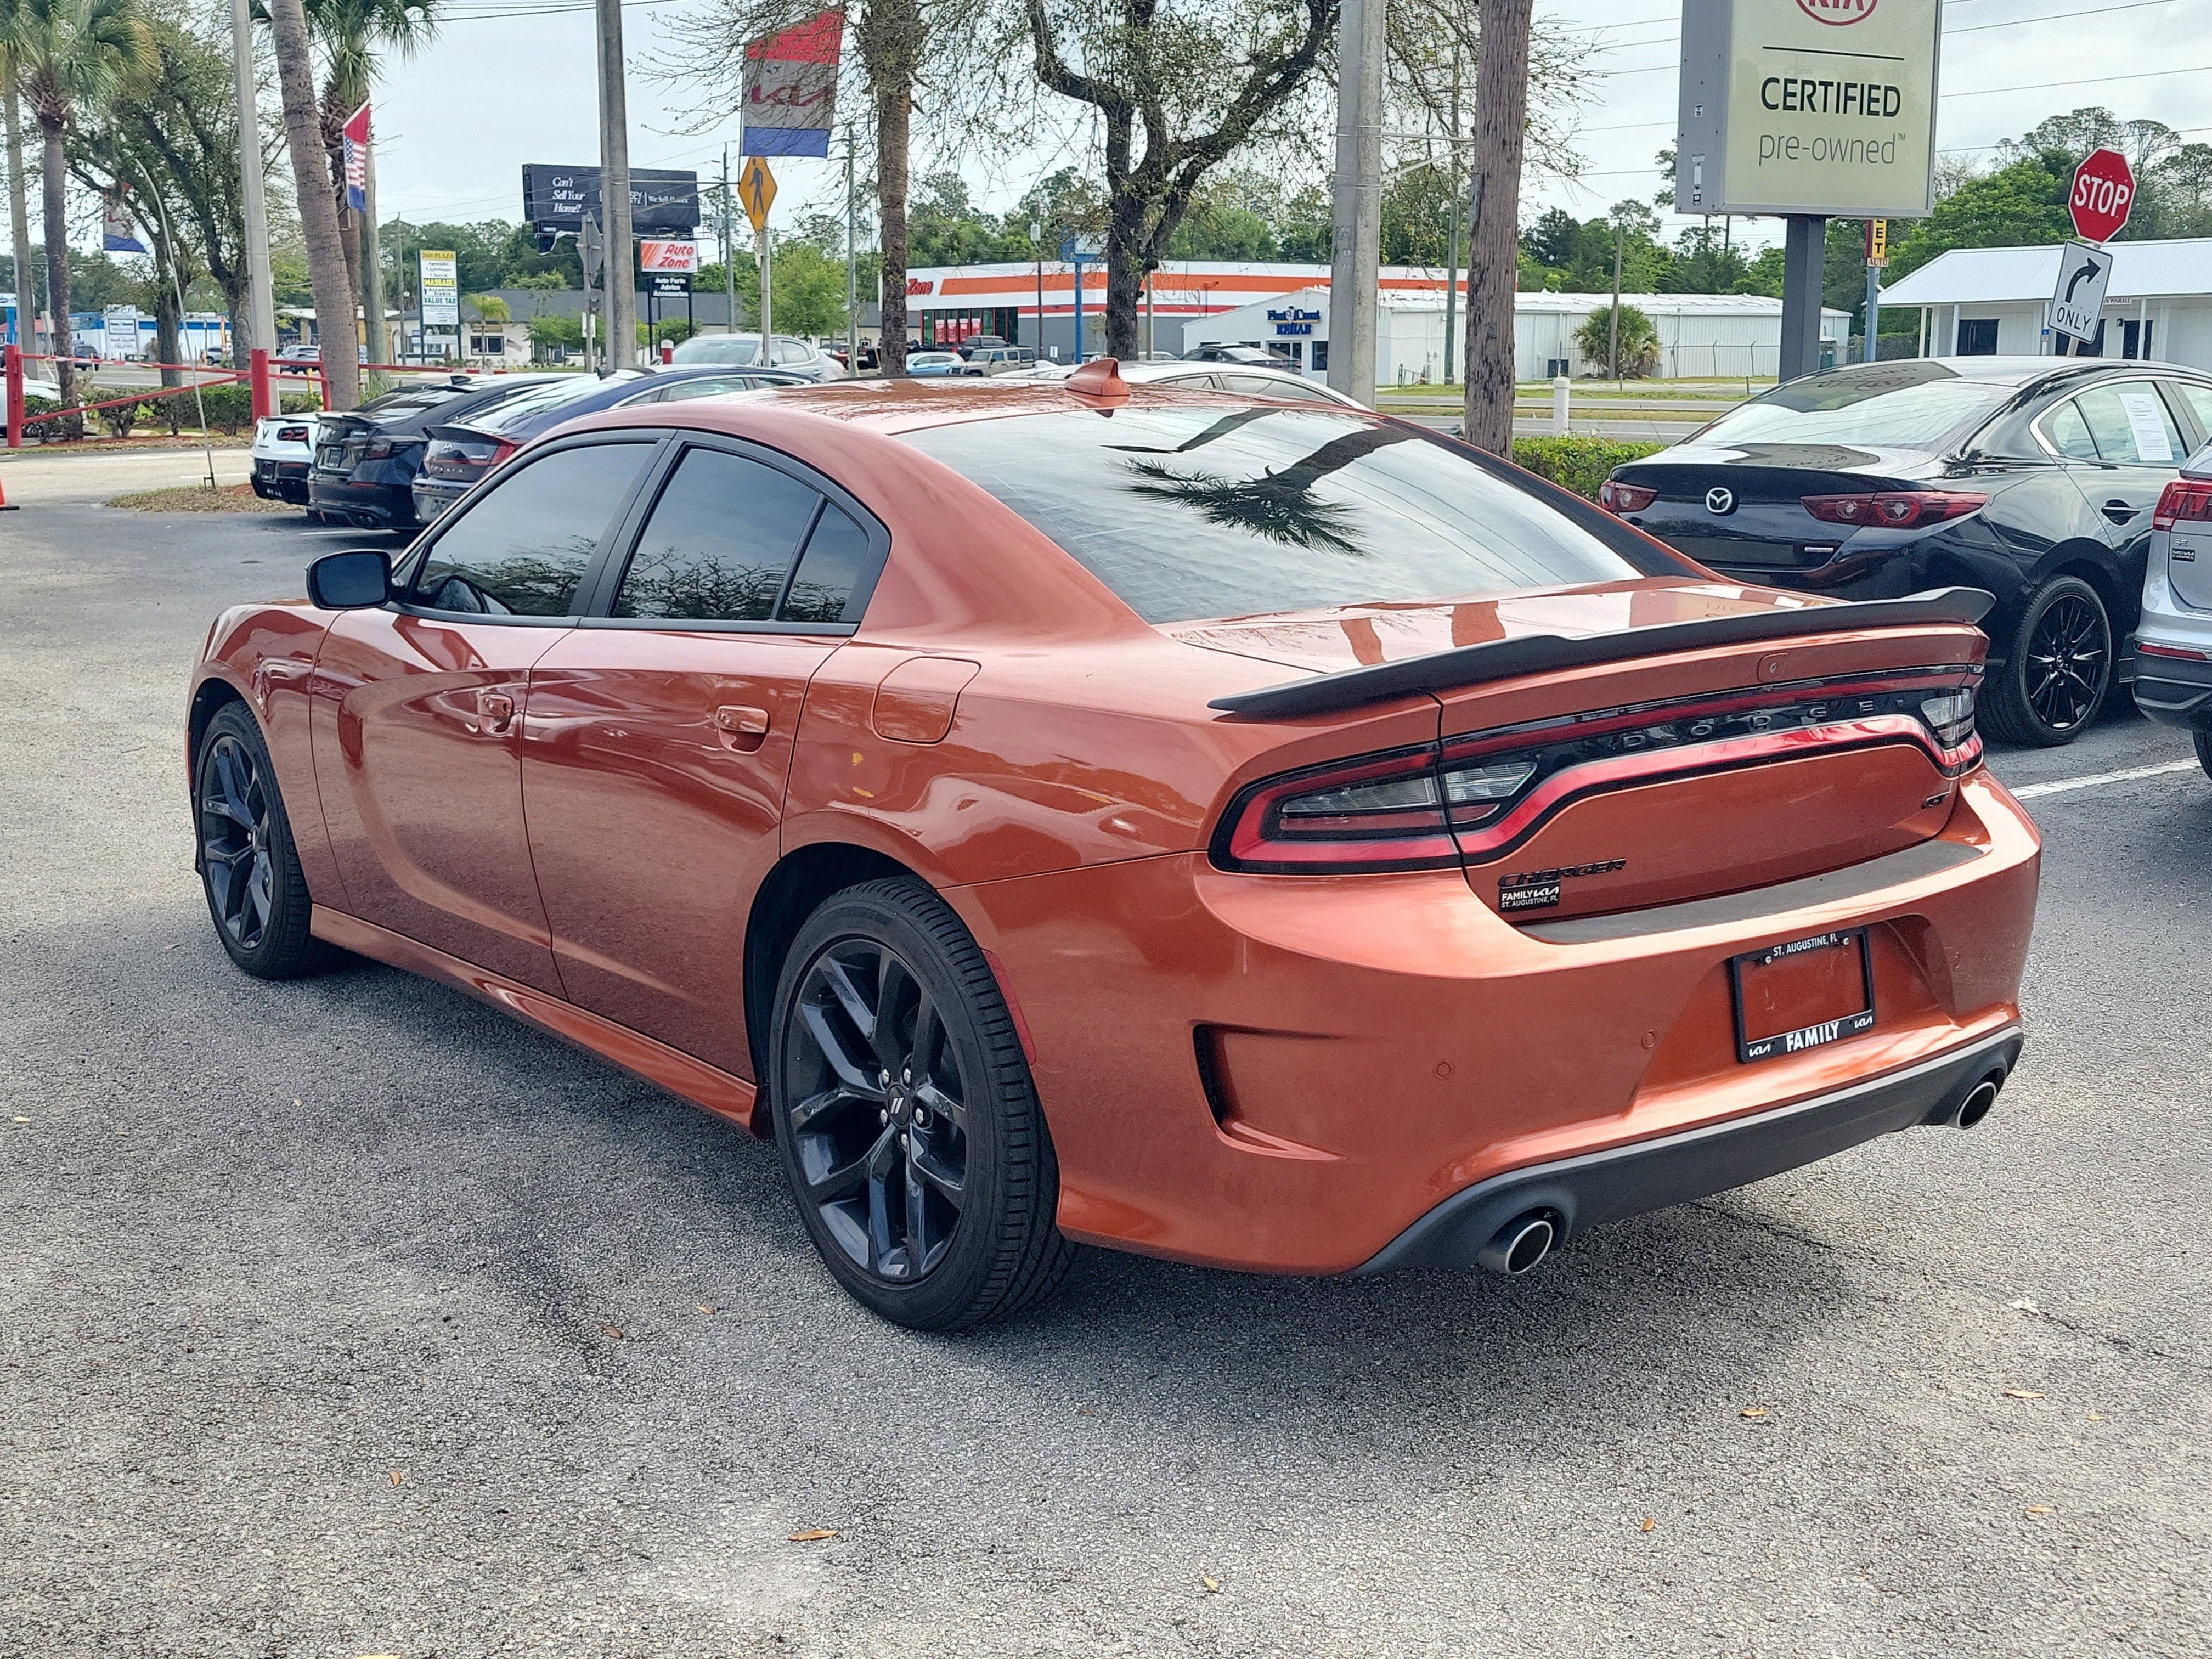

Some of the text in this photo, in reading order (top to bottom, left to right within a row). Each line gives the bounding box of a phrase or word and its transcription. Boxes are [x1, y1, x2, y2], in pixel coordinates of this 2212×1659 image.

[1760, 77, 1901, 117] CERTIFIED
[552, 177, 574, 187] Can't
[552, 189, 567, 200] Sell
[568, 190, 586, 200] Your
[2074, 174, 2129, 217] STOP
[552, 202, 582, 213] Home?
[664, 244, 694, 255] Auto
[658, 257, 690, 268] Zone
[906, 278, 933, 296] Zone
[2057, 306, 2091, 332] ONLY
[1621, 699, 1875, 749] DODGE
[1497, 858, 1627, 887] CHARGER
[1501, 889, 1534, 901] FAMILY
[1511, 896, 1550, 907] AUGUSTINE,
[1773, 933, 1838, 957] ST. AUGUSTINE, FL
[1786, 1021, 1840, 1053] FAMILY
